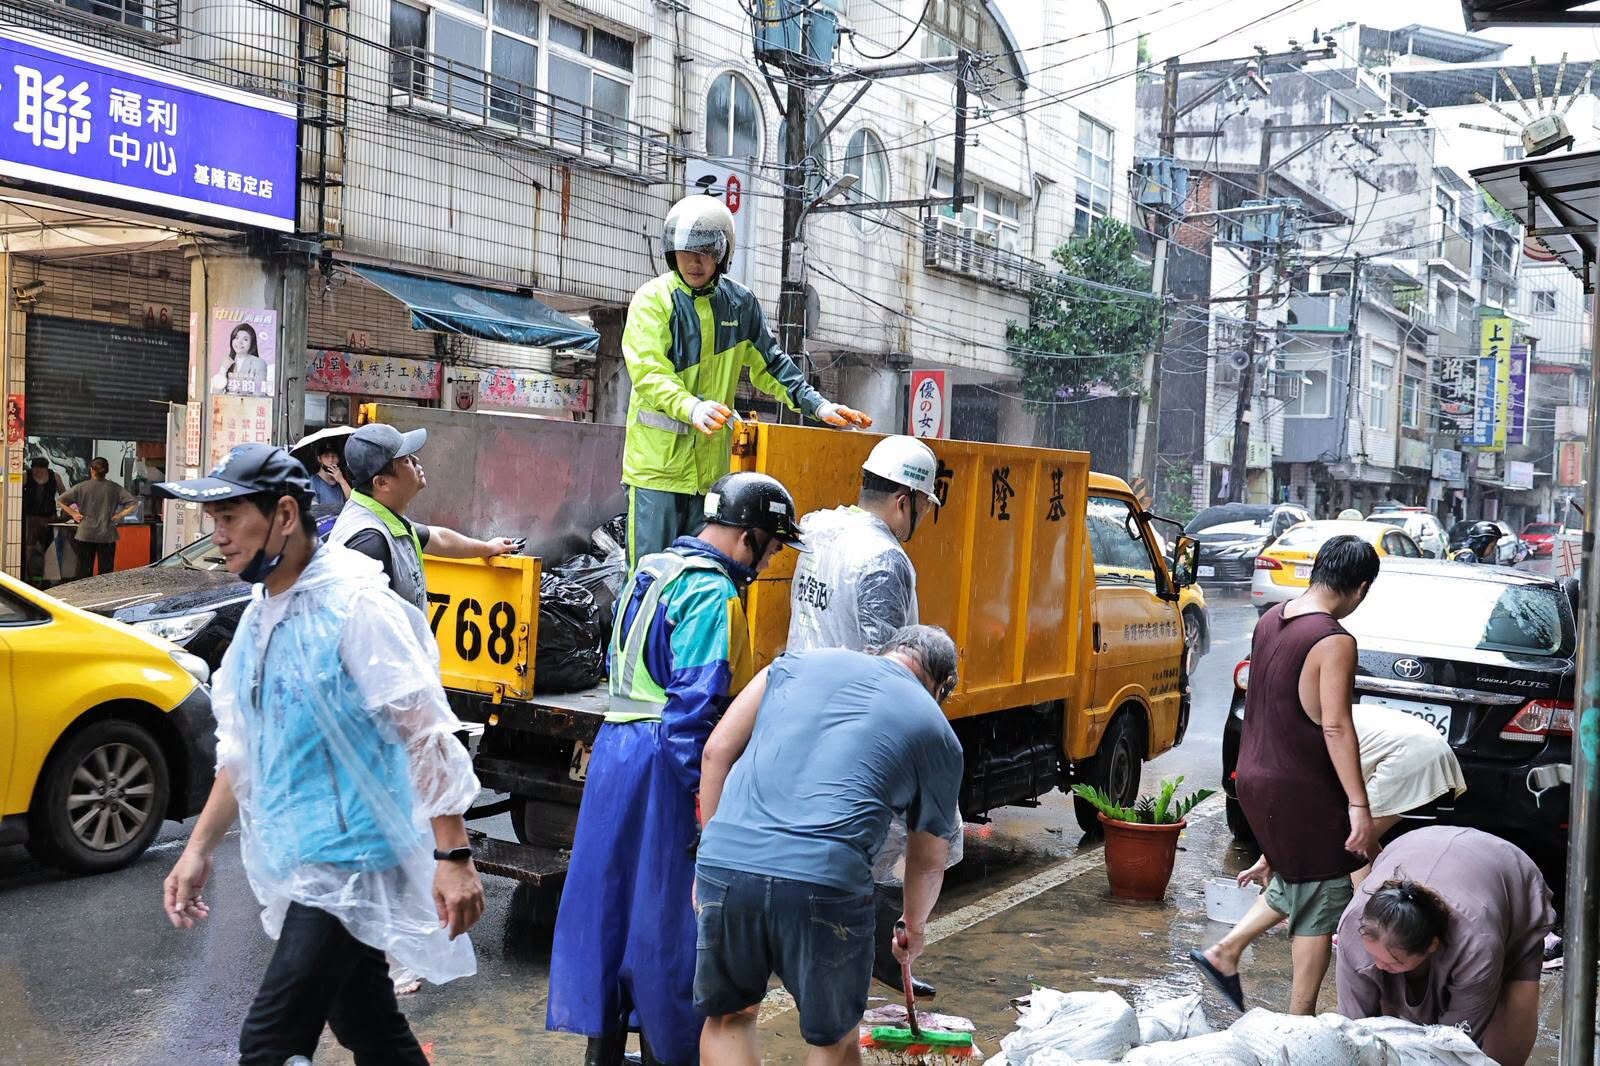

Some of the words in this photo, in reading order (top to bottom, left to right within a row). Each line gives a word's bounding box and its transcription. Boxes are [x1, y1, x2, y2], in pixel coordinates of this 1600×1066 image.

[13, 65, 92, 154] 聯
[108, 87, 178, 136] 福利
[109, 131, 177, 177] 中心
[193, 163, 274, 199] 基隆西定店
[426, 591, 516, 665] 768
[1509, 679, 1551, 689] ALTIS
